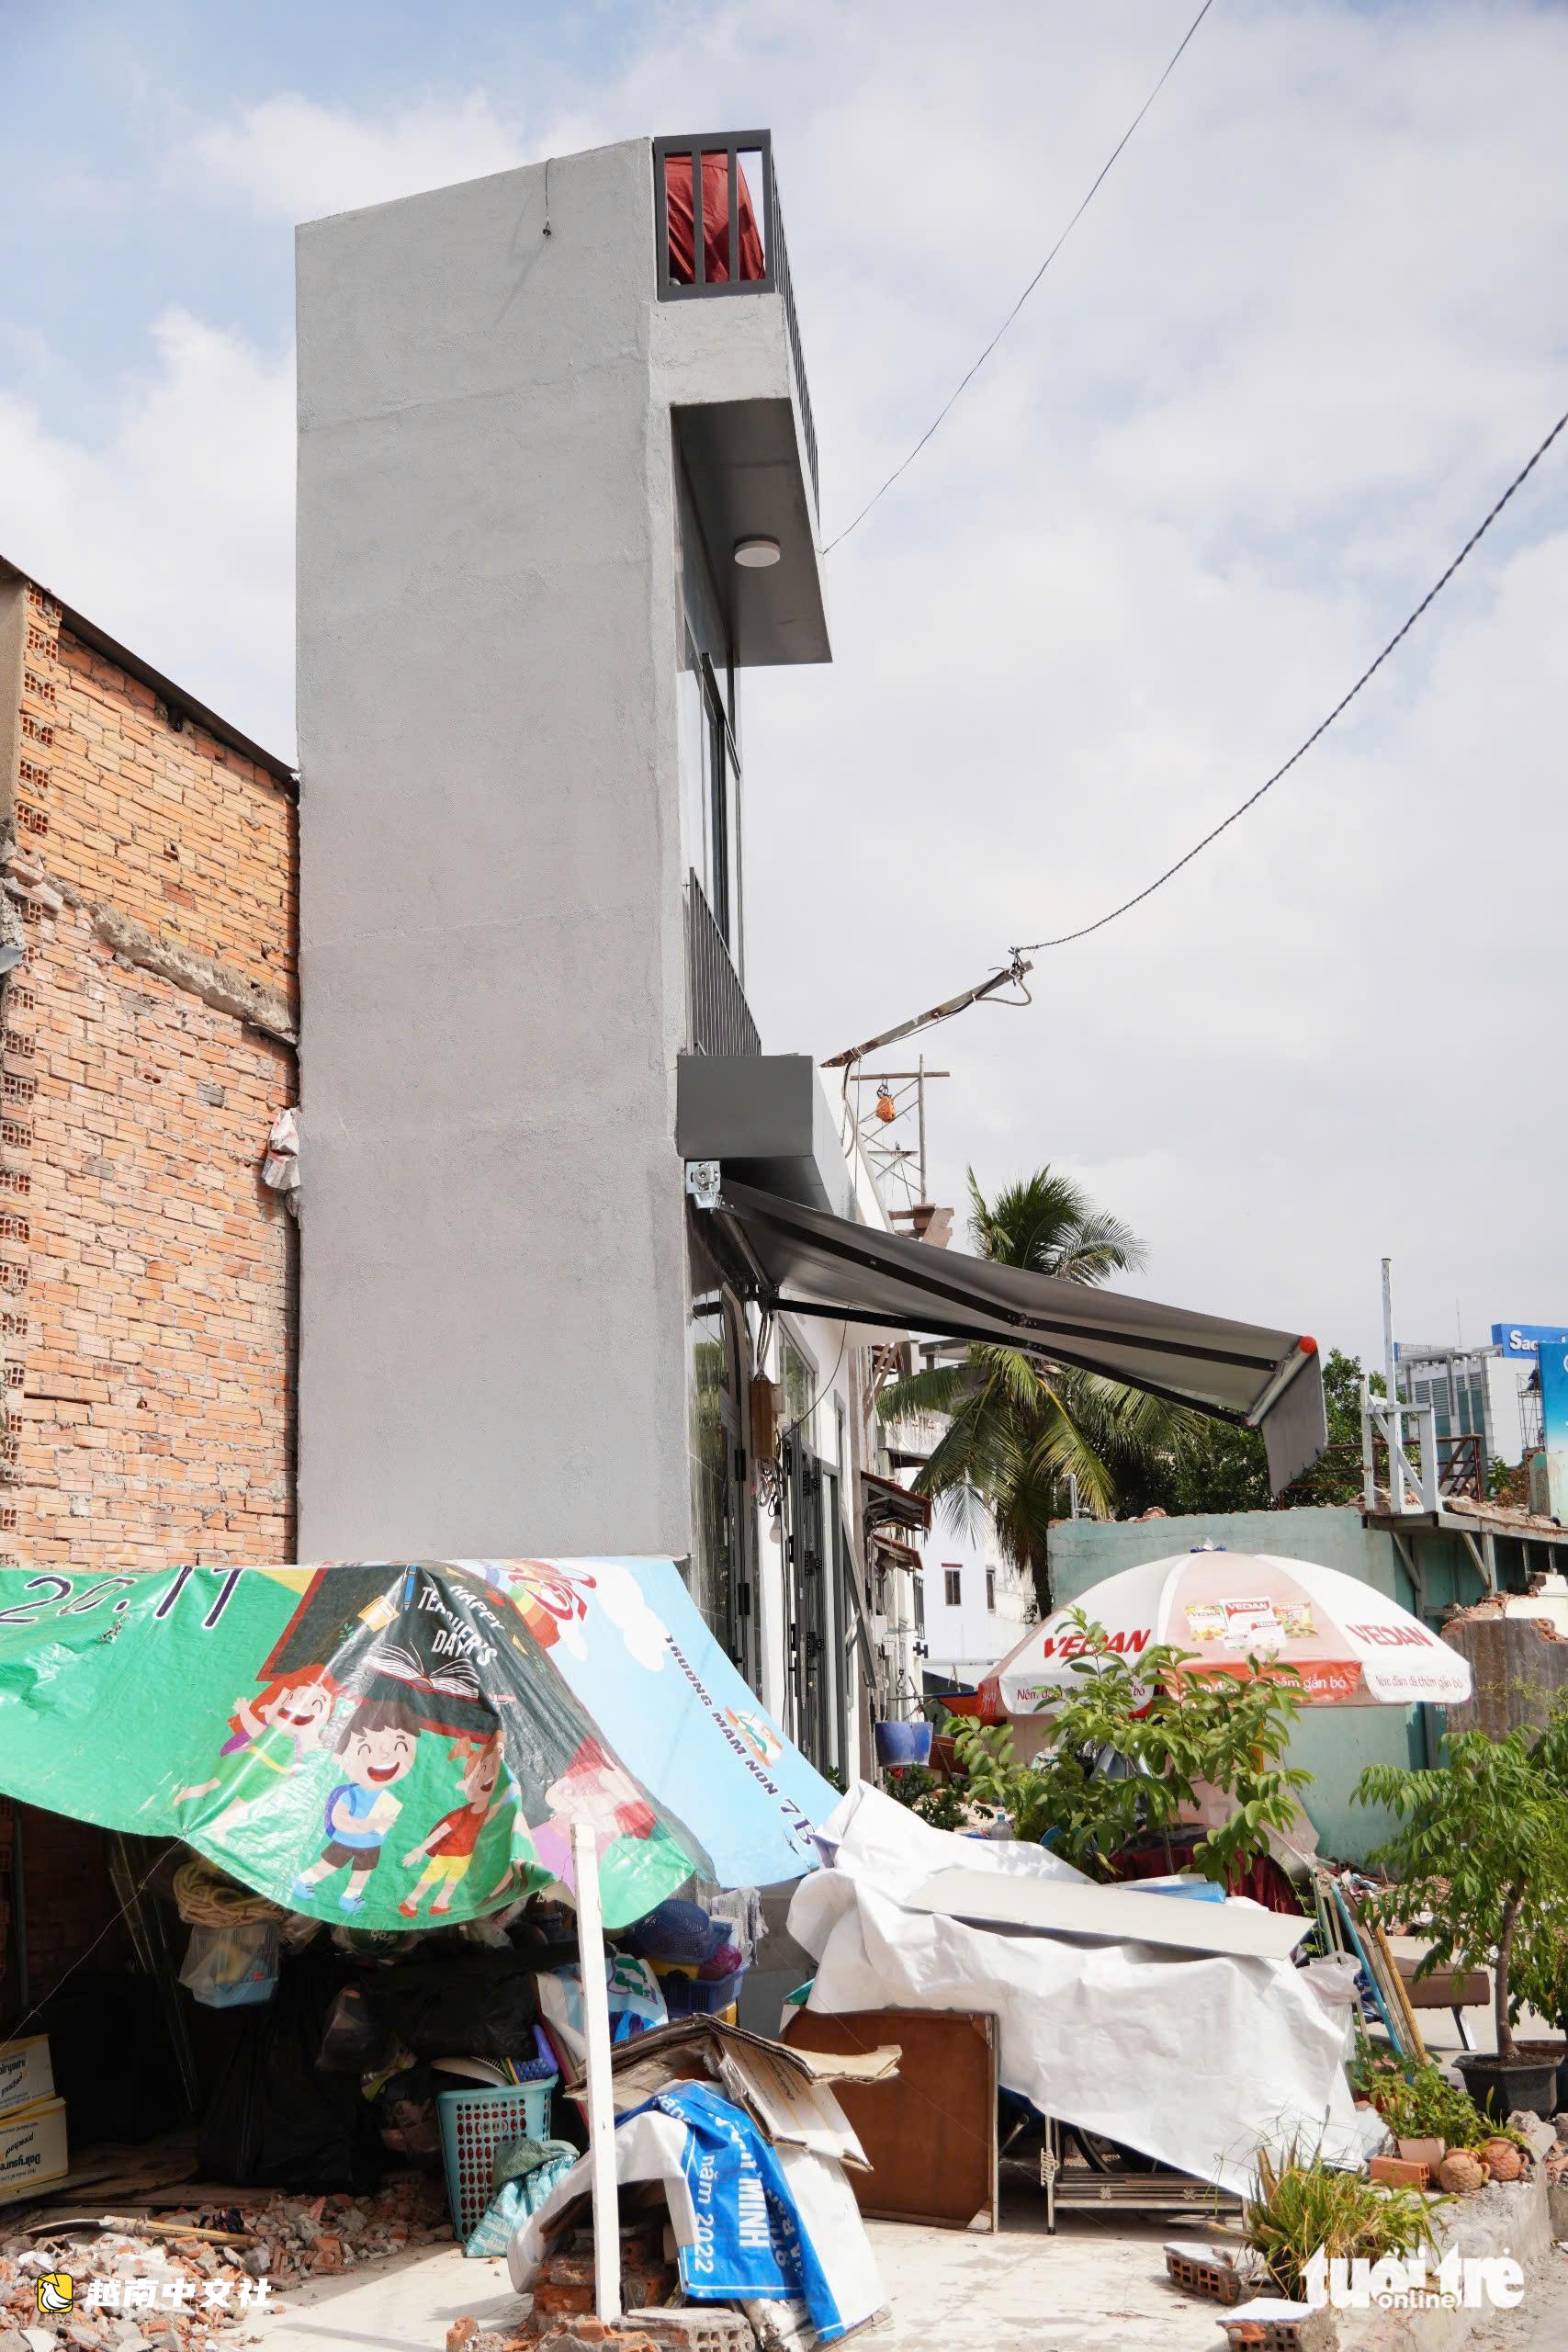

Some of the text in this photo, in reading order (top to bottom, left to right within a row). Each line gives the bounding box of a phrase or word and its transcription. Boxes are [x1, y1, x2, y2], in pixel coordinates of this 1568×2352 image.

[1344, 1623, 1435, 1647] VEDAN
[694, 2211, 715, 2274] 2022
[738, 2177, 771, 2247] MINH
